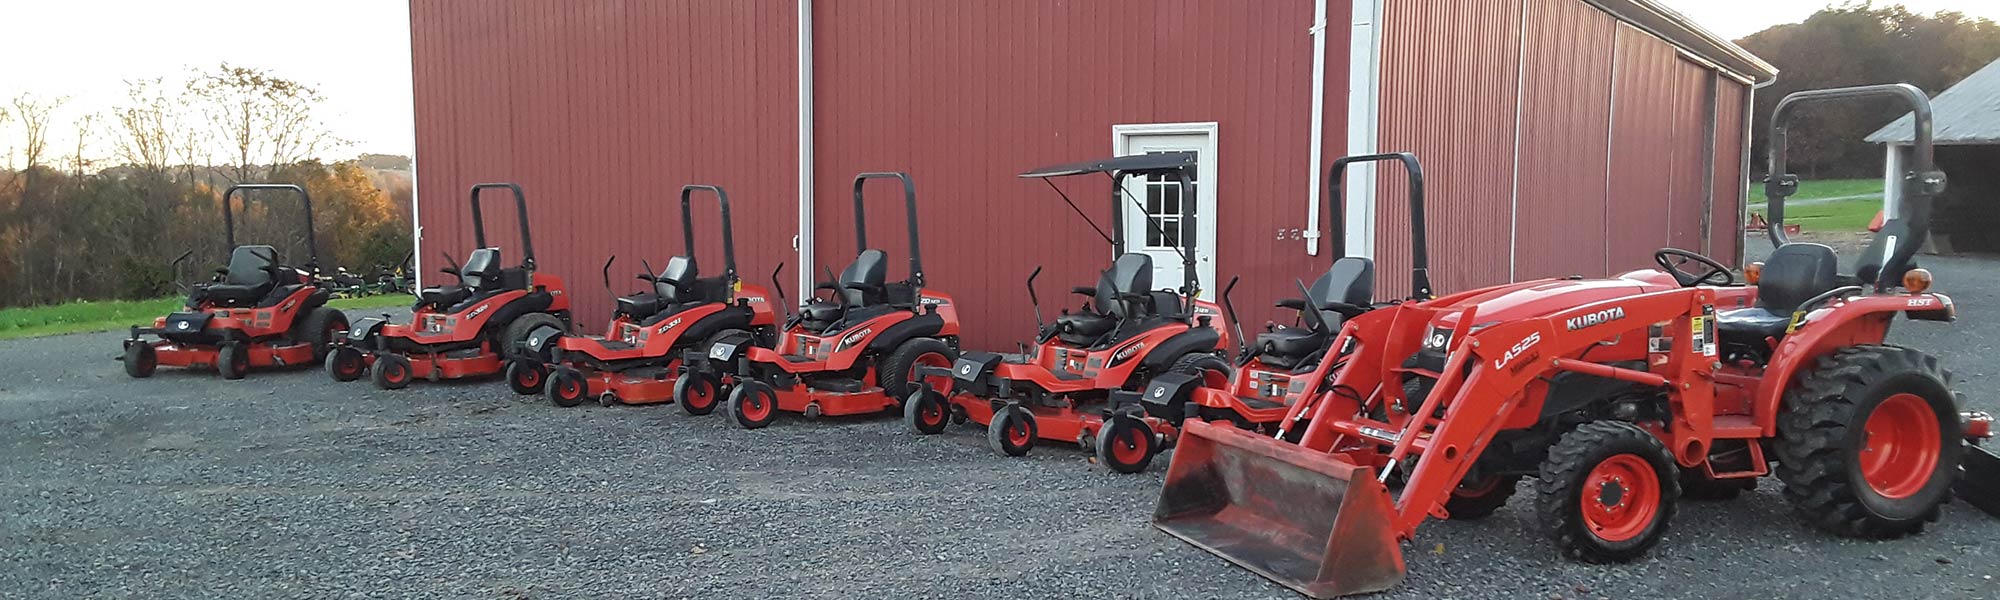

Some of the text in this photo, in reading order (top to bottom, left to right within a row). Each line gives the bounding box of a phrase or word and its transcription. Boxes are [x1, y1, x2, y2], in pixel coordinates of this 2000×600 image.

[1907, 298, 1933, 307] HST
[1566, 306, 1625, 331] KUBOTA
[844, 328, 872, 345] KUBOTA
[1116, 342, 1145, 361] KUBOTA
[1494, 331, 1541, 370] LA525
